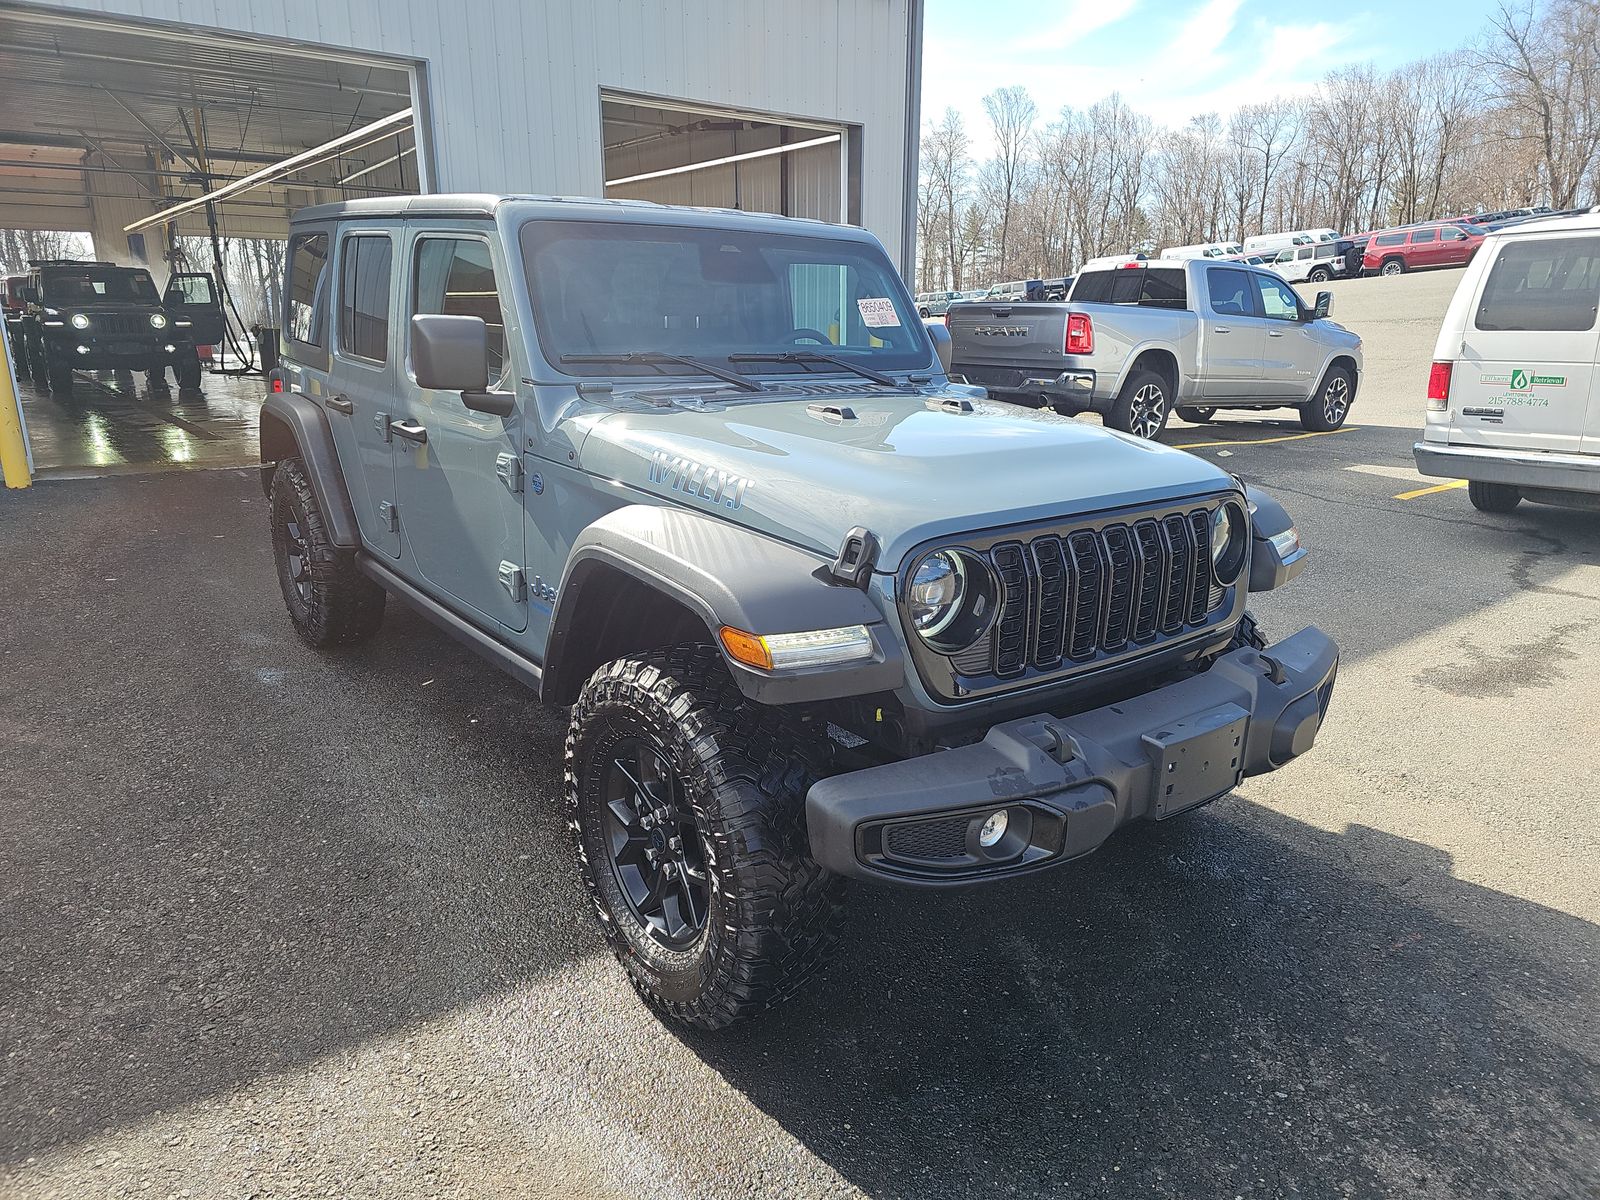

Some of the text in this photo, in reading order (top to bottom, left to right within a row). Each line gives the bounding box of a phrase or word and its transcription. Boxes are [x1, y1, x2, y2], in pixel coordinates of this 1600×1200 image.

[974, 326, 1029, 337] RAM
[1488, 397, 1549, 407] 215-788-4774
[649, 451, 755, 510] WILLYS
[530, 575, 558, 604] Jee
